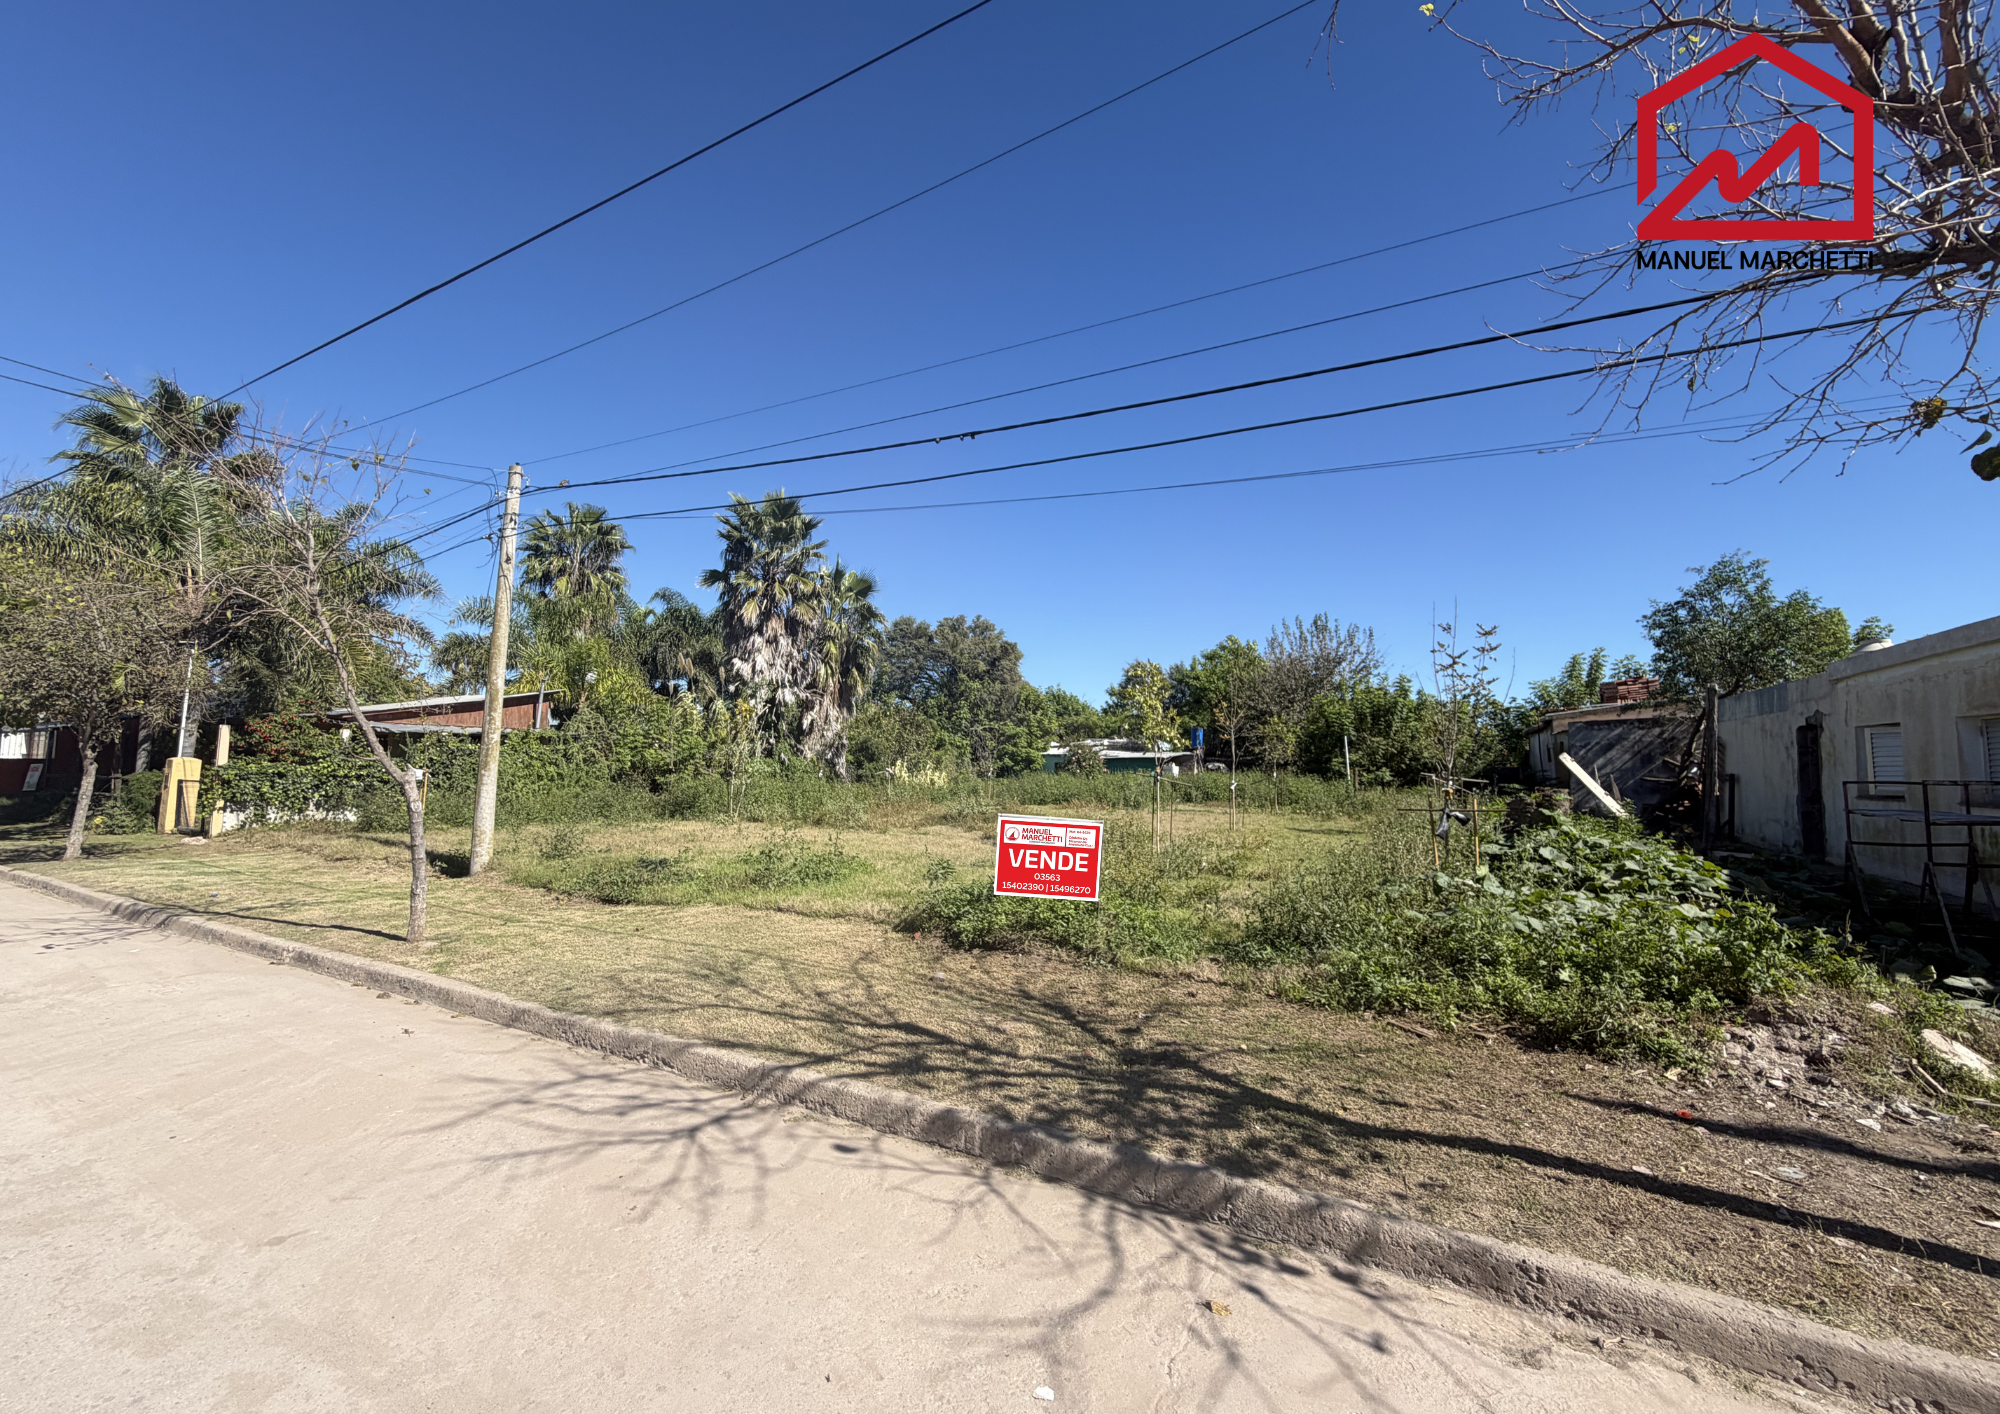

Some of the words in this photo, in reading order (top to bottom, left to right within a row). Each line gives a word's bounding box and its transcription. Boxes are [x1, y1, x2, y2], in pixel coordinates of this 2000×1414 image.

[1021, 827, 1053, 836] MANUEL
[1021, 833, 1063, 843] MARCHETTI
[1008, 848, 1089, 872] VENDE
[1033, 872, 1061, 882] 03563
[1002, 881, 1044, 891] 15402390
[1049, 884, 1091, 894] 15496270
